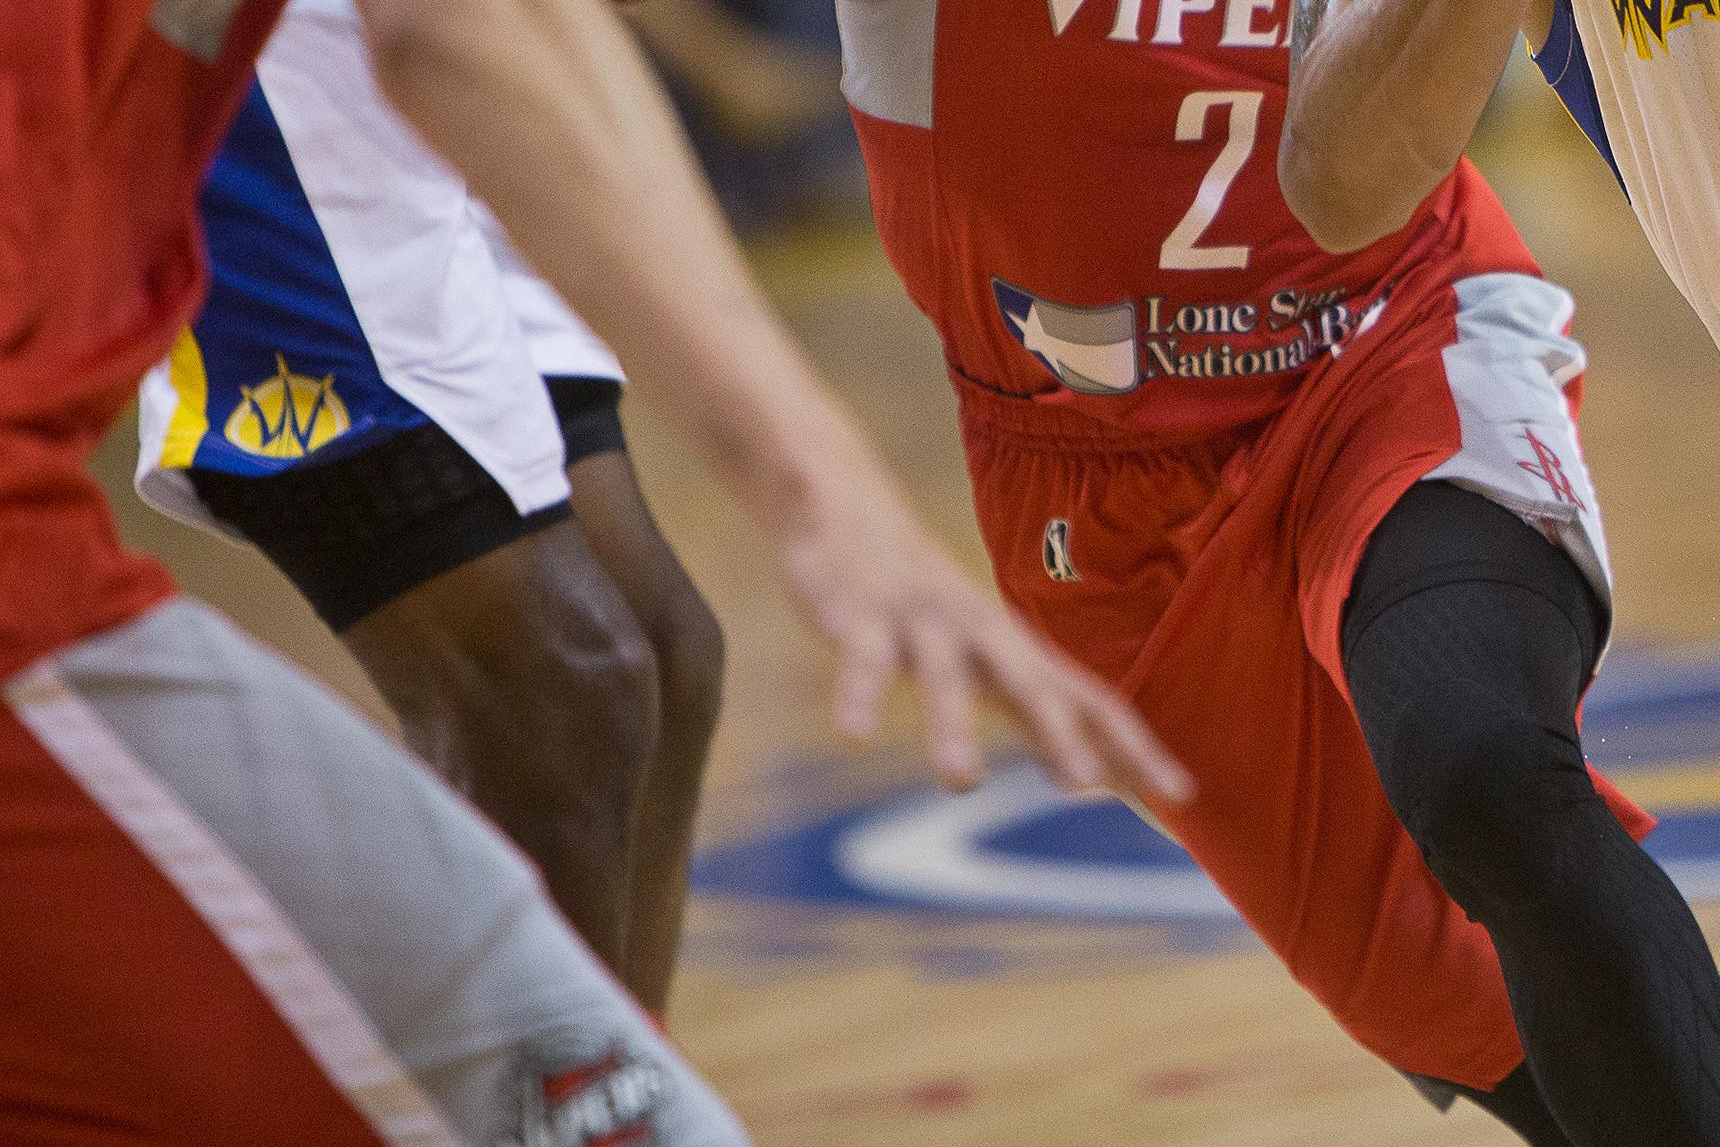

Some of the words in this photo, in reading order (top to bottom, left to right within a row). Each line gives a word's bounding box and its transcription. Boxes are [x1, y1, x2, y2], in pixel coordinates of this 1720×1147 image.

[1158, 89, 1265, 271] 2
[1144, 296, 1258, 334] Lone
[1146, 317, 1316, 379] National
